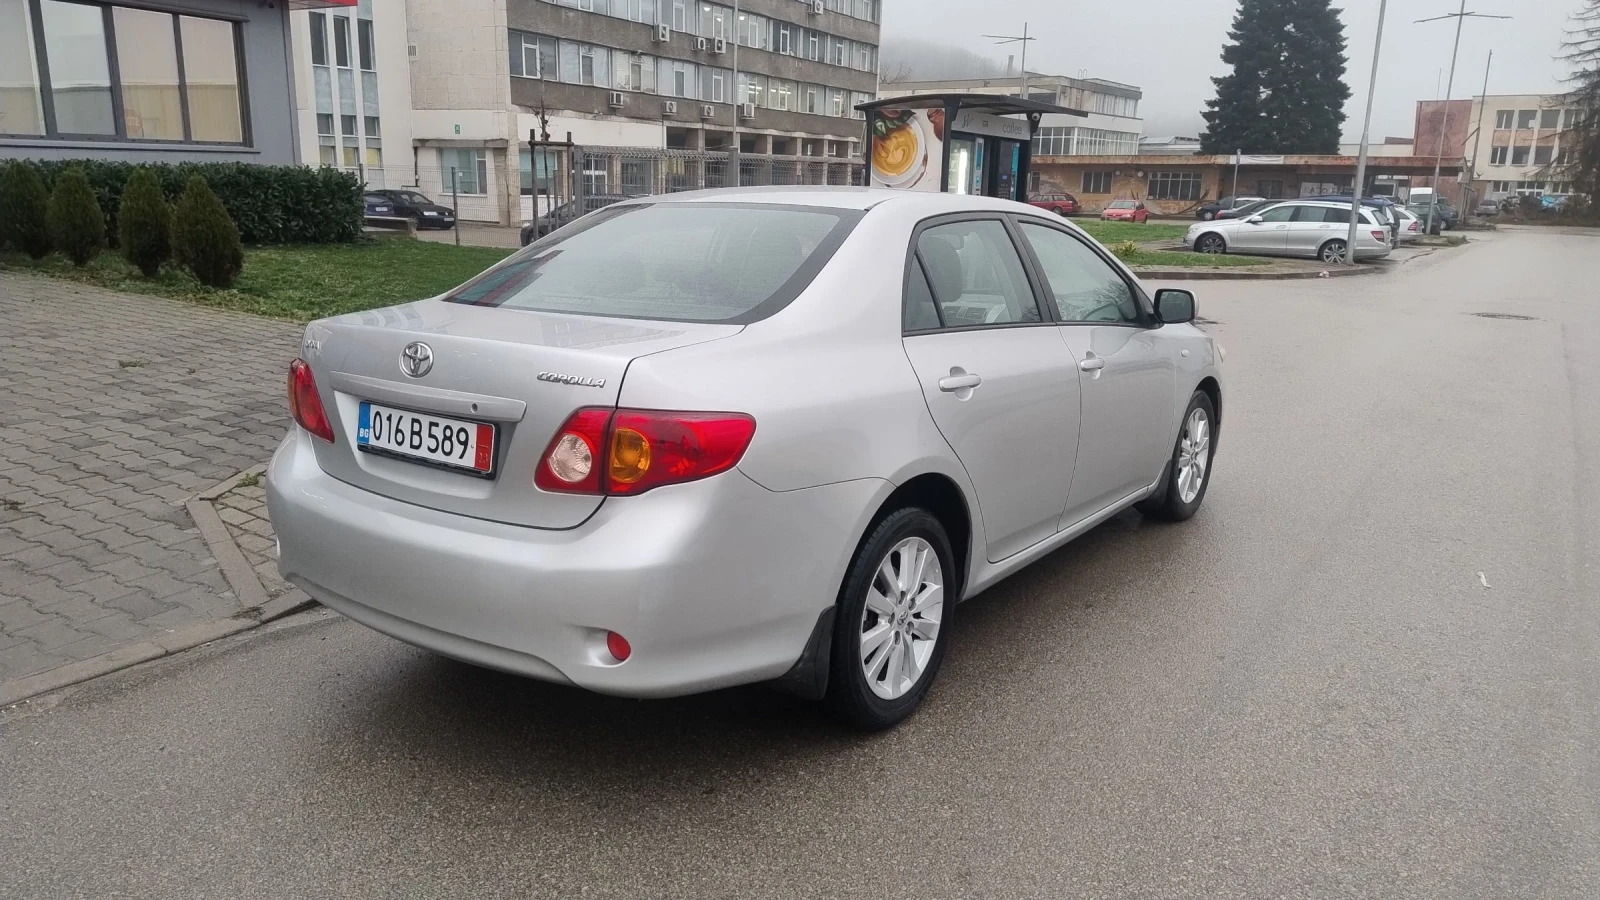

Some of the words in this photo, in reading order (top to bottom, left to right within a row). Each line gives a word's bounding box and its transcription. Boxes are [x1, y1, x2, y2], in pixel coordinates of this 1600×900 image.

[1002, 122, 1023, 135] coffee
[537, 371, 606, 388] COROLLA
[359, 428, 369, 438] BG
